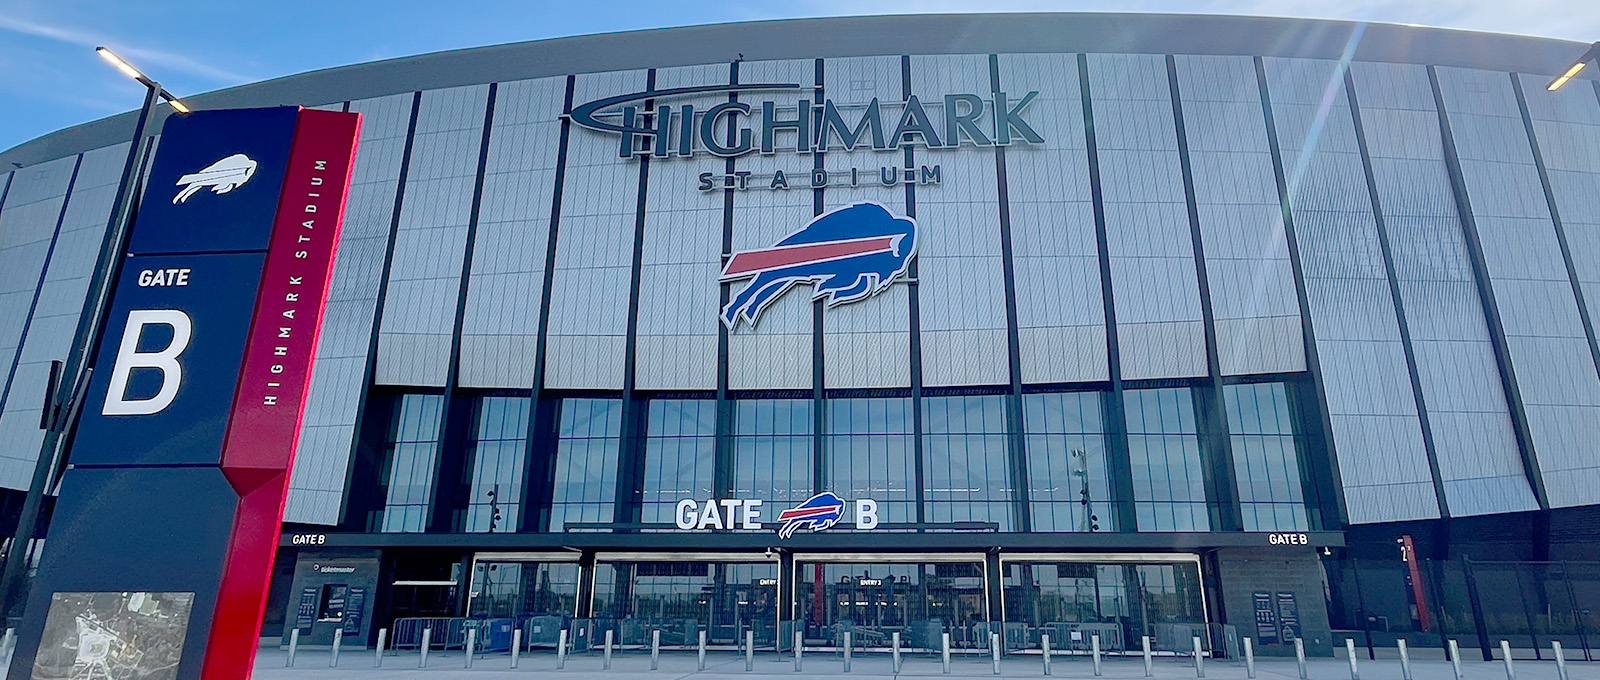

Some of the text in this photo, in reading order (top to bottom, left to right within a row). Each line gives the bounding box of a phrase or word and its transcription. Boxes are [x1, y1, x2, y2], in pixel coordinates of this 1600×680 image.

[570, 85, 1046, 159] HIGHMARK
[698, 165, 942, 191] STADIUM
[137, 268, 191, 287] GATE
[263, 160, 327, 406] HIGHMARK STADIUM
[101, 309, 192, 416] B
[675, 498, 879, 530] GATE B
[292, 534, 326, 545] GATE B
[1269, 533, 1308, 545] GATE B
